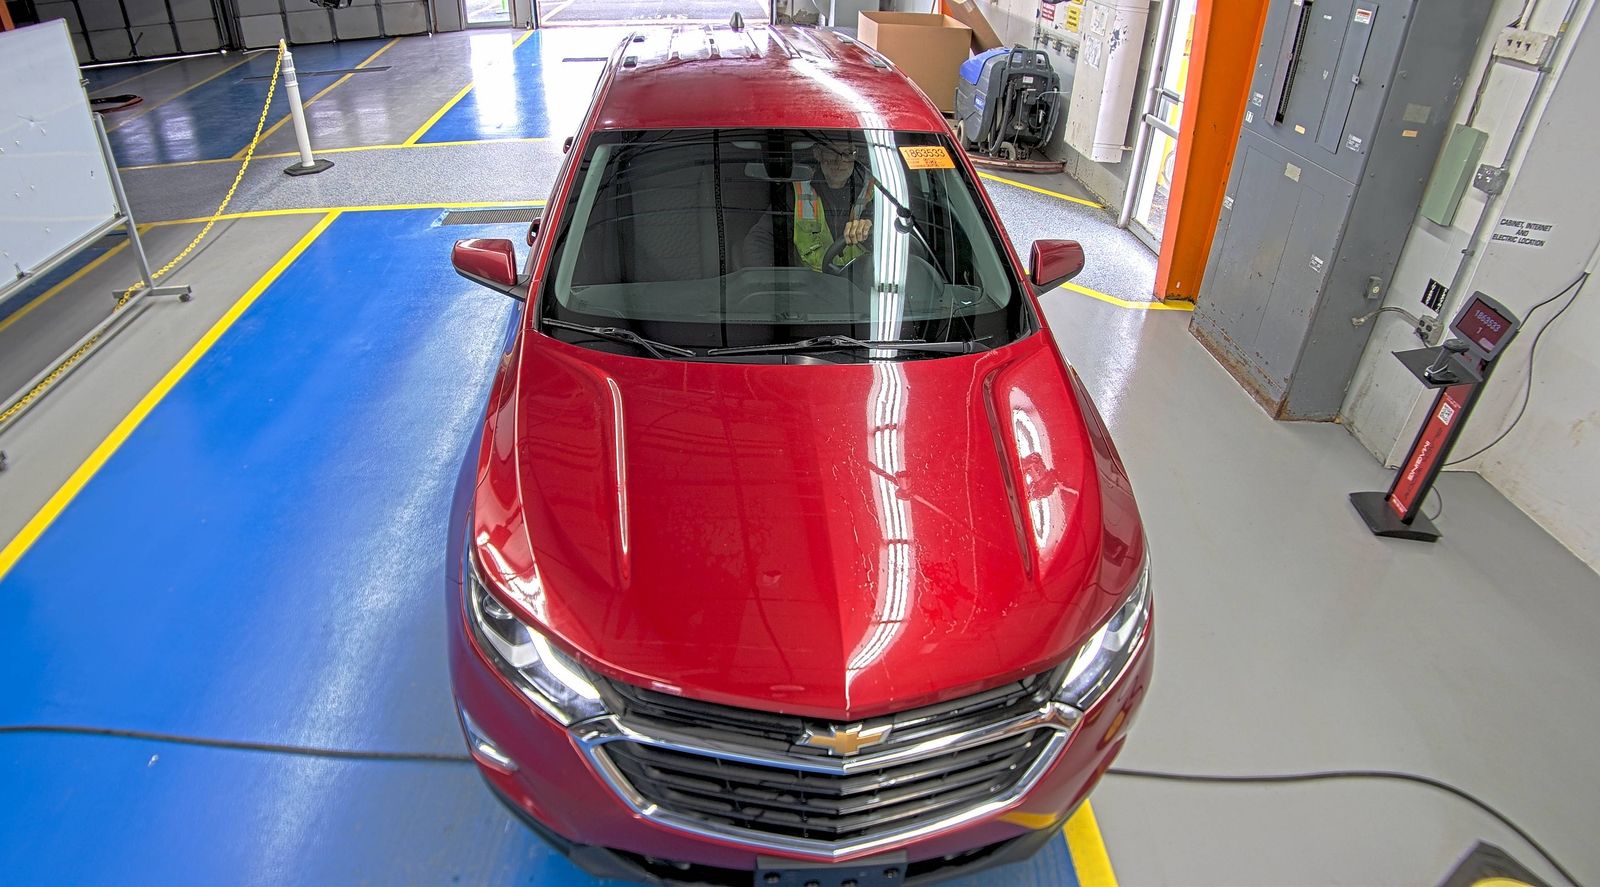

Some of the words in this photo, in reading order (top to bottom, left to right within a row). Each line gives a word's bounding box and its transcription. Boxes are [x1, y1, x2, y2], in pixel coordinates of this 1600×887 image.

[904, 148, 946, 158] 1863533
[1526, 223, 1552, 231] INTERNET
[1492, 234, 1518, 242] ELECTRIC
[1518, 238, 1545, 246] LOCATION
[1475, 310, 1501, 332] 1863533
